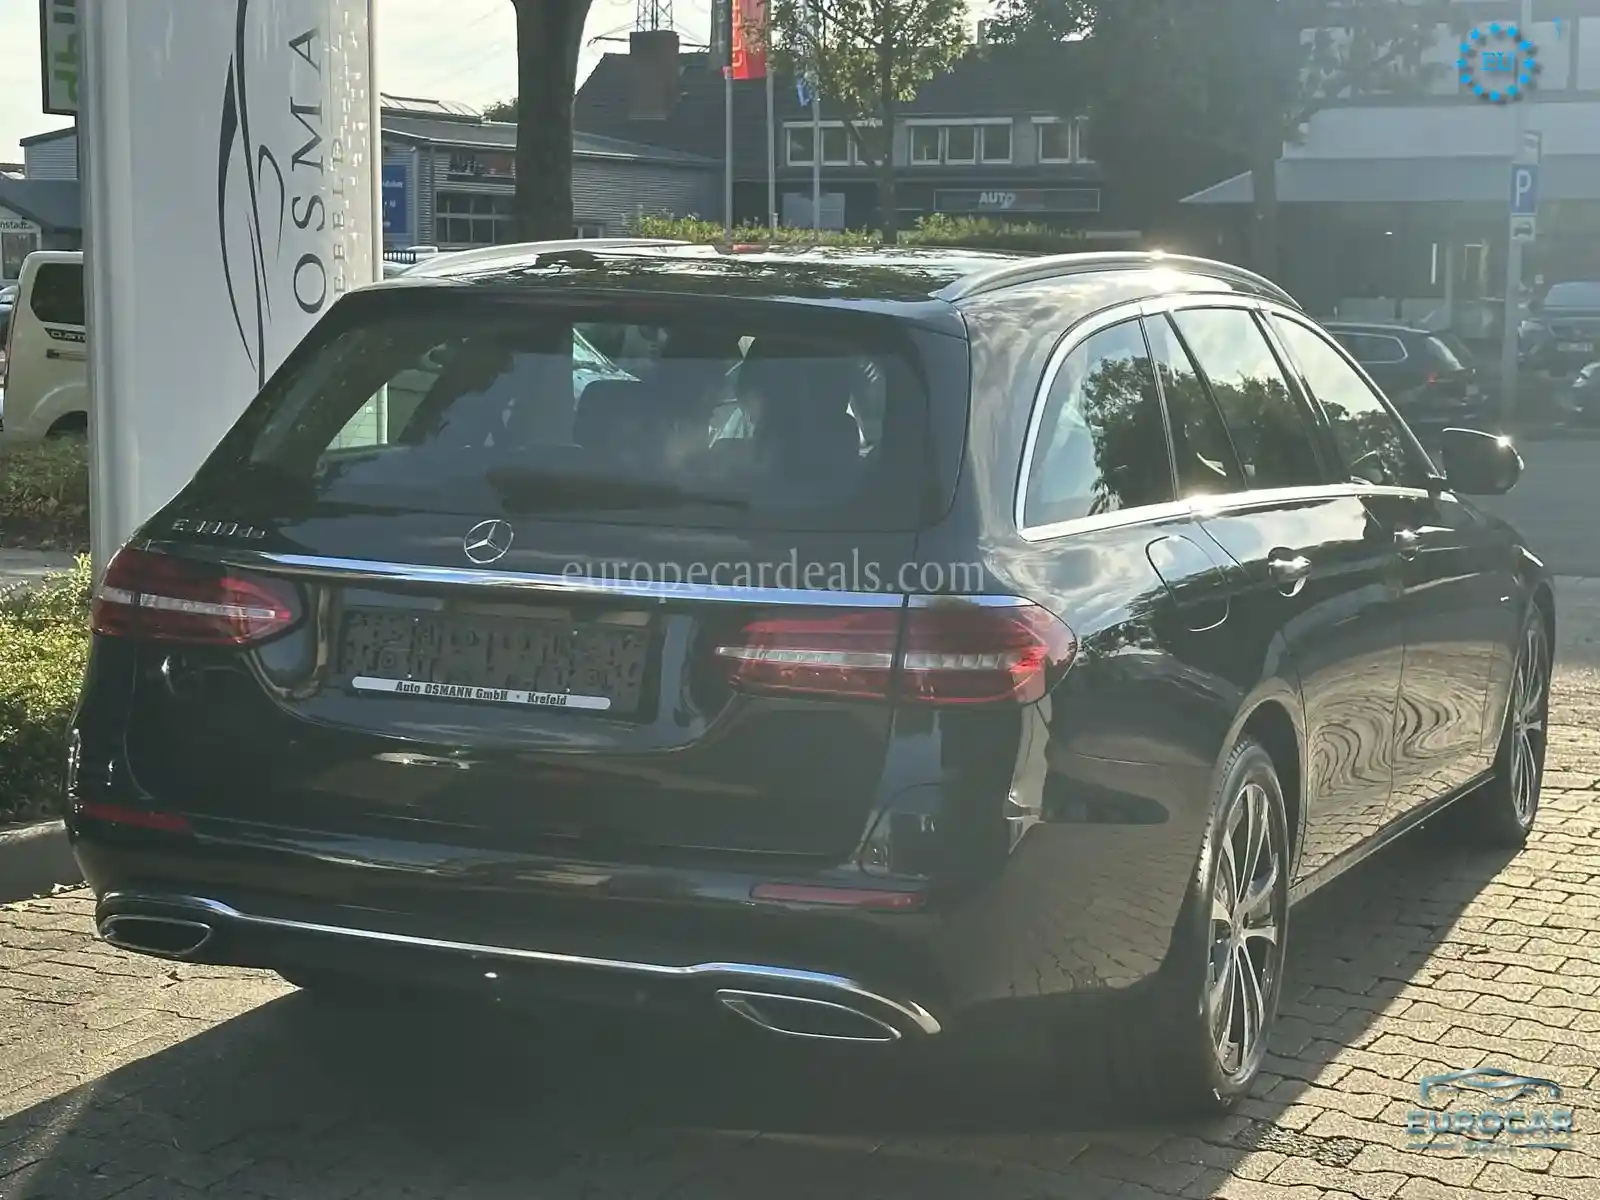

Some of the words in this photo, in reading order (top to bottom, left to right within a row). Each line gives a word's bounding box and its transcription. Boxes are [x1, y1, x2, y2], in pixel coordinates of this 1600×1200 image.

[1516, 169, 1532, 208] P
[396, 681, 421, 694] Auto
[424, 683, 473, 698] OSMANN
[475, 688, 508, 701] GmbH
[527, 692, 567, 706] Krefeld
